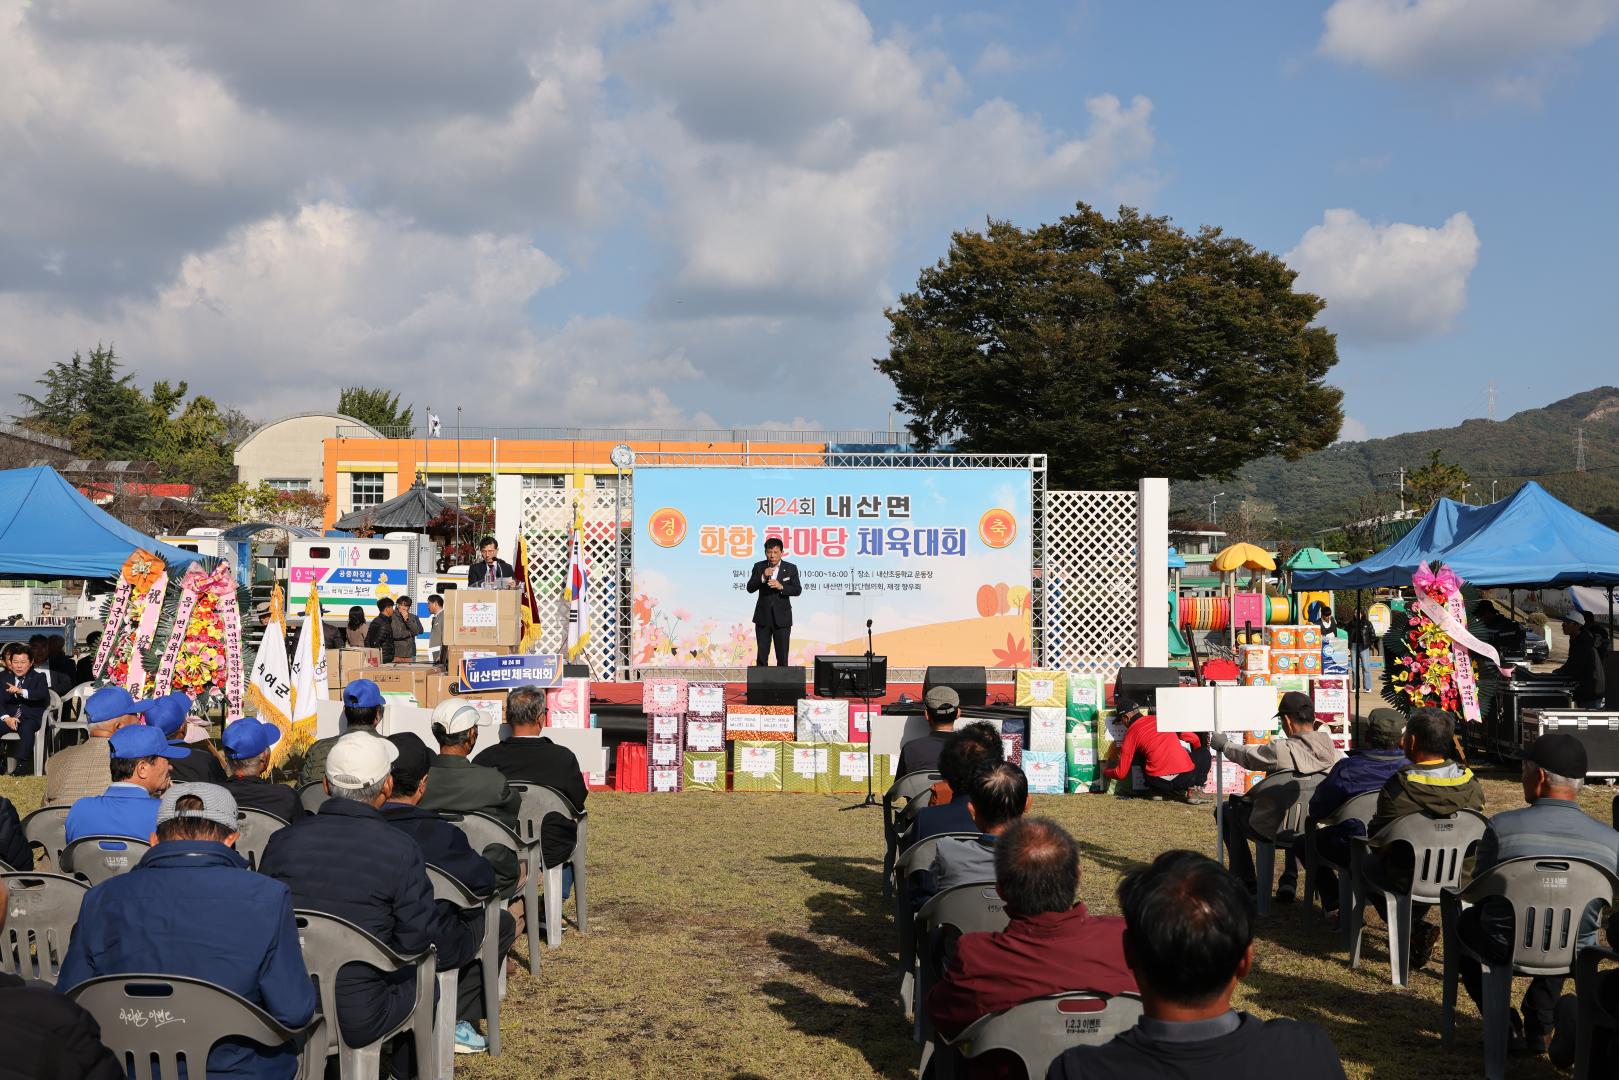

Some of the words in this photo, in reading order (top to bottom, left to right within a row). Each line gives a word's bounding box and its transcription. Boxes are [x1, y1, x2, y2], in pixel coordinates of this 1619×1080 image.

[756, 497, 815, 516] 제24회
[826, 496, 910, 518] 내산면
[660, 517, 675, 536] 경
[990, 518, 1008, 537] 축
[700, 526, 756, 558] 화합
[764, 526, 848, 558] 한마당
[856, 527, 966, 558] 체육대회
[339, 570, 372, 578] 공중화장실
[732, 570, 746, 578] 일시
[803, 570, 849, 578] 10:00~16:00
[857, 570, 870, 579] 장소
[876, 570, 913, 579] 내산초등학교
[914, 570, 933, 579] 운동장
[732, 582, 746, 590] 주관
[803, 582, 817, 591] 후원
[823, 582, 843, 591] 내산면
[469, 667, 553, 683] 내산면민체육대회
[1065, 1019, 1081, 1028] 1.2.3
[1083, 1018, 1101, 1028] 이벤트
